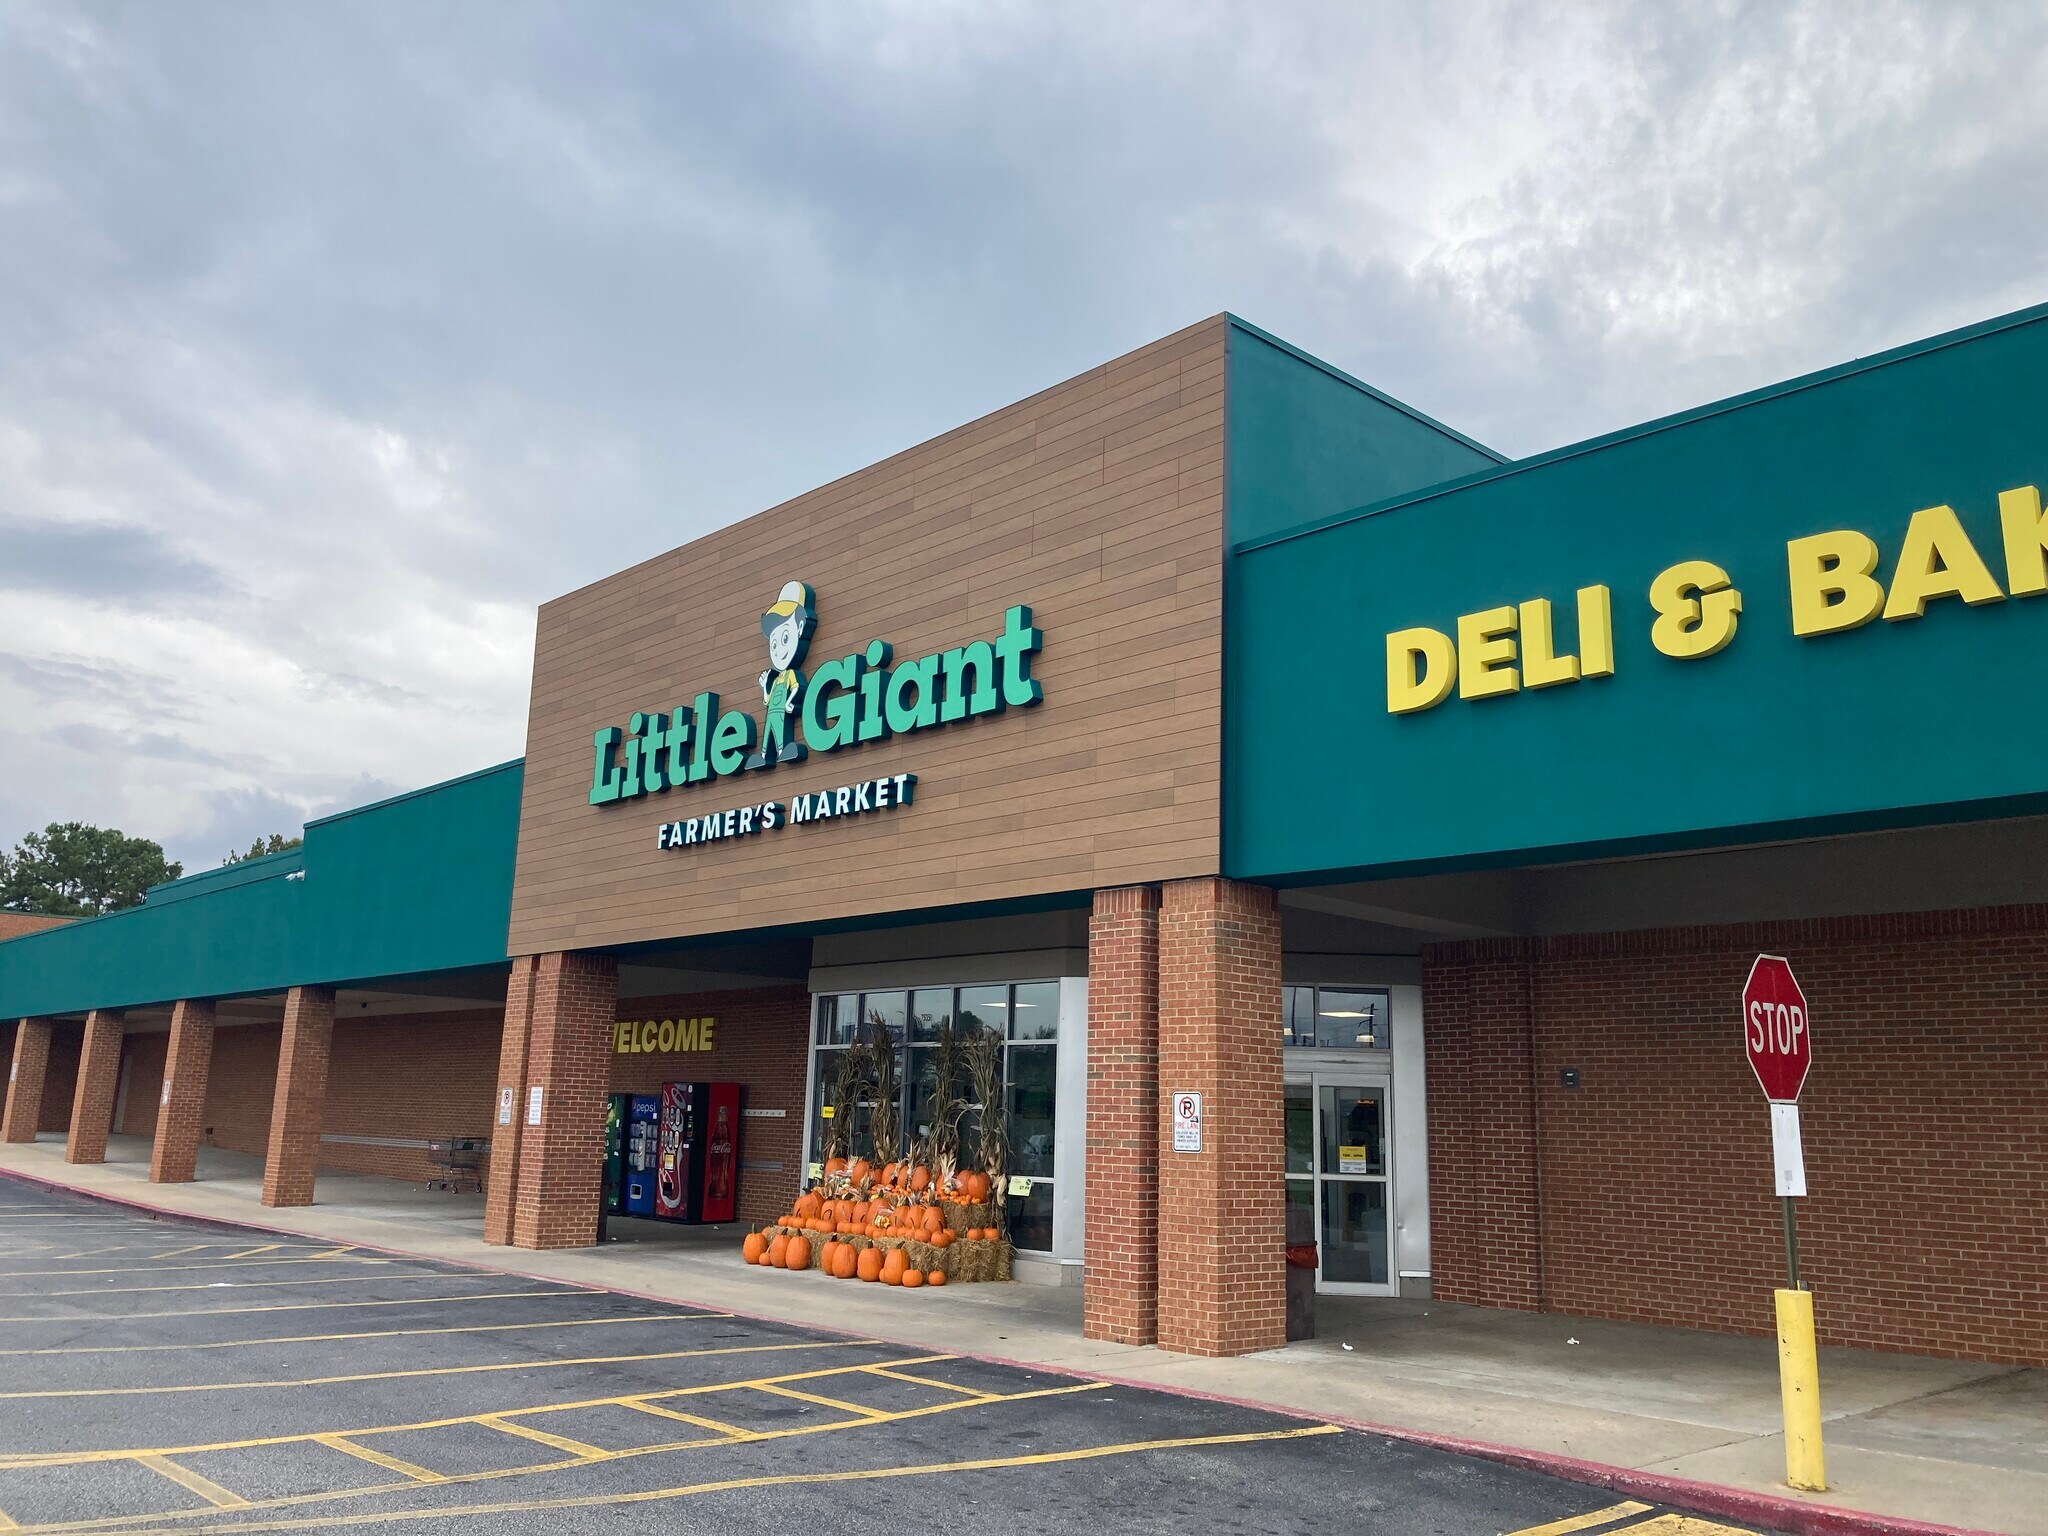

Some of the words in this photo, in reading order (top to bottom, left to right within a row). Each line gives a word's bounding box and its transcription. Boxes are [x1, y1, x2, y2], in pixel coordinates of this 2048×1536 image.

[1386, 584, 1614, 714] DELI
[1649, 560, 1742, 660] &
[589, 691, 754, 806] Little
[802, 604, 1042, 752] Giant
[657, 802, 784, 850] FARMER'S
[790, 774, 916, 825] MARKET
[1751, 1001, 1803, 1055] STOP
[636, 1102, 656, 1114] pepsi
